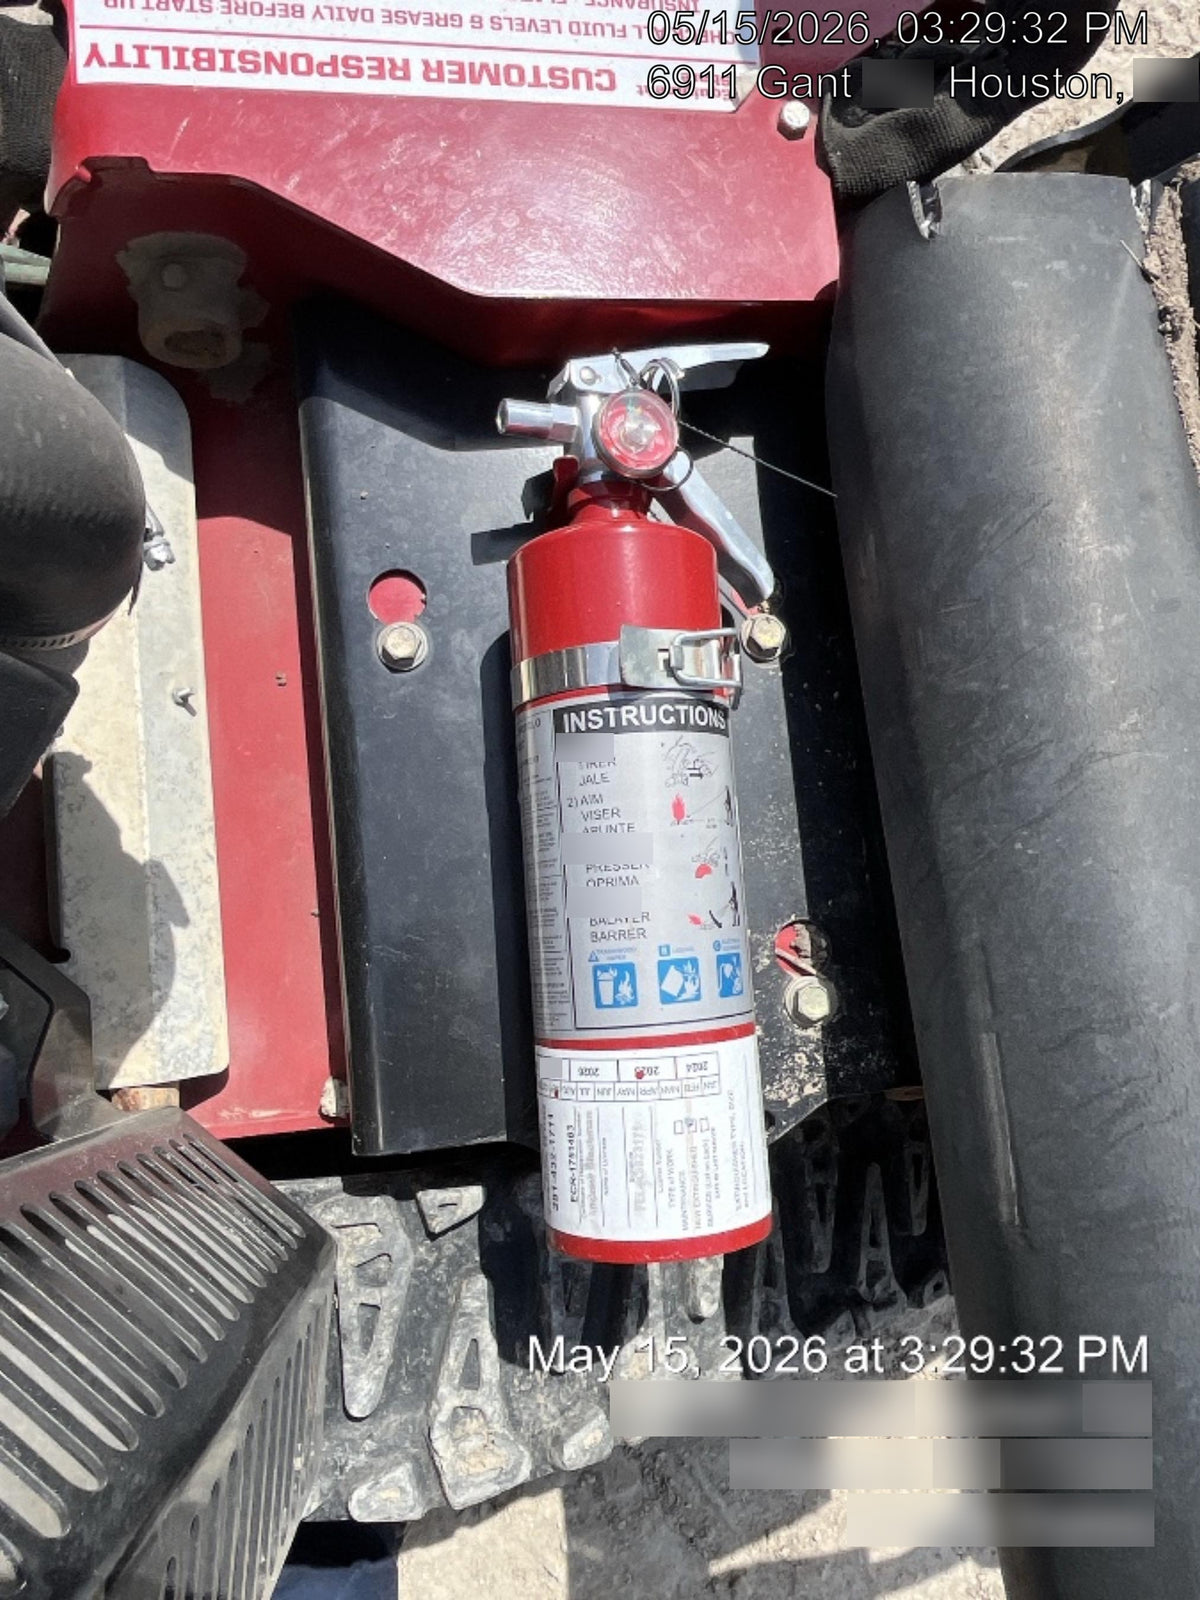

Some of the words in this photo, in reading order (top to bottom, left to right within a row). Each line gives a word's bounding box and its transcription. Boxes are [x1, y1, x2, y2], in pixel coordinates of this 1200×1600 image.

[220, 0, 305, 19] BEFORE
[312, 5, 375, 23] DAILY
[382, 8, 464, 28] GREASE
[469, 14, 484, 29] &
[489, 15, 563, 34] LEVELS
[569, 19, 627, 39] FLUID
[83, 42, 412, 81] RESPONSIBILITY
[421, 58, 617, 92] CUSTOMER
[562, 704, 726, 734] INSTRUCTIONS
[579, 772, 610, 787] JALE
[580, 793, 604, 807] AIM
[581, 806, 621, 822] VISER
[586, 875, 640, 888] OPRIMA
[590, 926, 648, 943] BARRER
